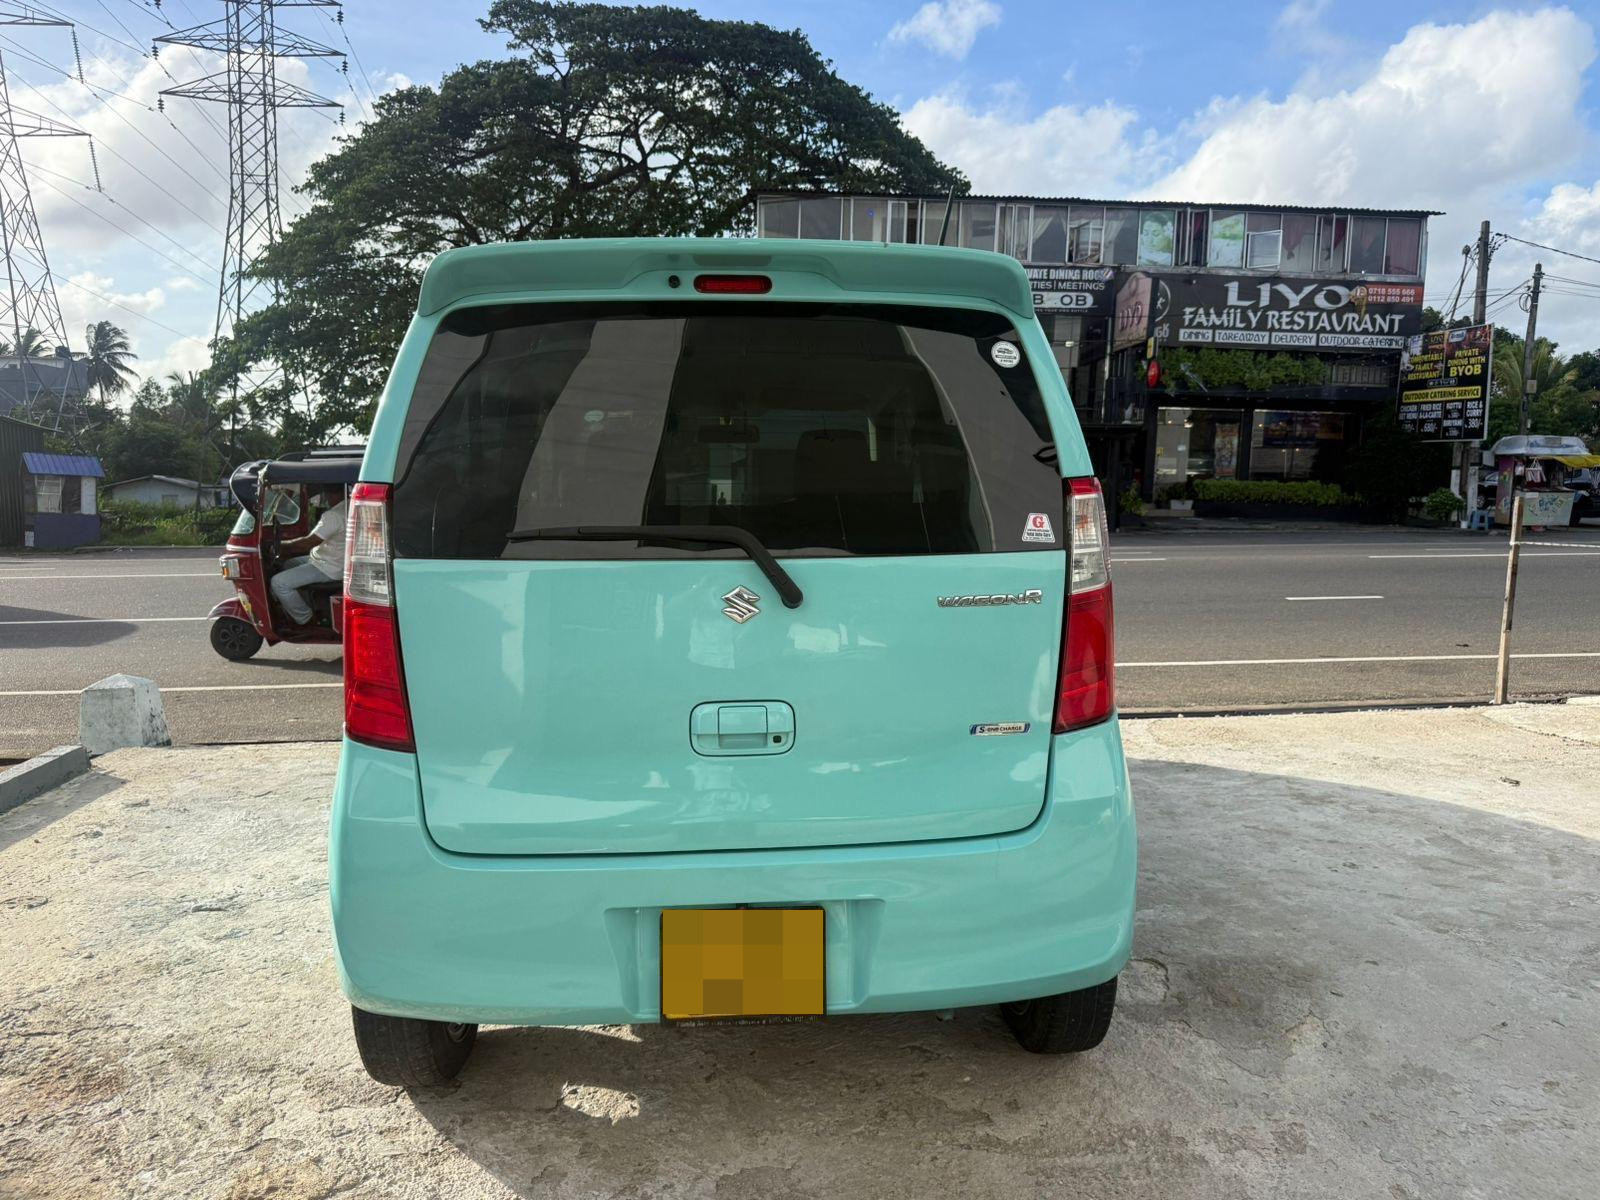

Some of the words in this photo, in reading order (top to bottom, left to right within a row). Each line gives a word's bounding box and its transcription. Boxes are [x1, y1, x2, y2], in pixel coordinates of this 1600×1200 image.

[1049, 269, 1080, 280] DINING
[1058, 281, 1105, 291] MEETINGS
[1224, 281, 1351, 310] LIYO
[1182, 306, 1263, 329] FAMILY
[1266, 309, 1406, 334] RESTAURANT
[1182, 330, 1210, 341] DINING
[1217, 331, 1267, 344] TAKEAWAY
[1274, 333, 1314, 345] DELIVERY
[1455, 348, 1479, 358] PRIVATE
[1469, 356, 1486, 365] WITH
[1449, 364, 1482, 377] BYOB
[1404, 391, 1429, 401] OUTDOOR
[1430, 389, 1456, 399] CATERING
[1457, 387, 1480, 398] SERVICE
[1467, 401, 1478, 409] RICE
[1032, 515, 1045, 528] G
